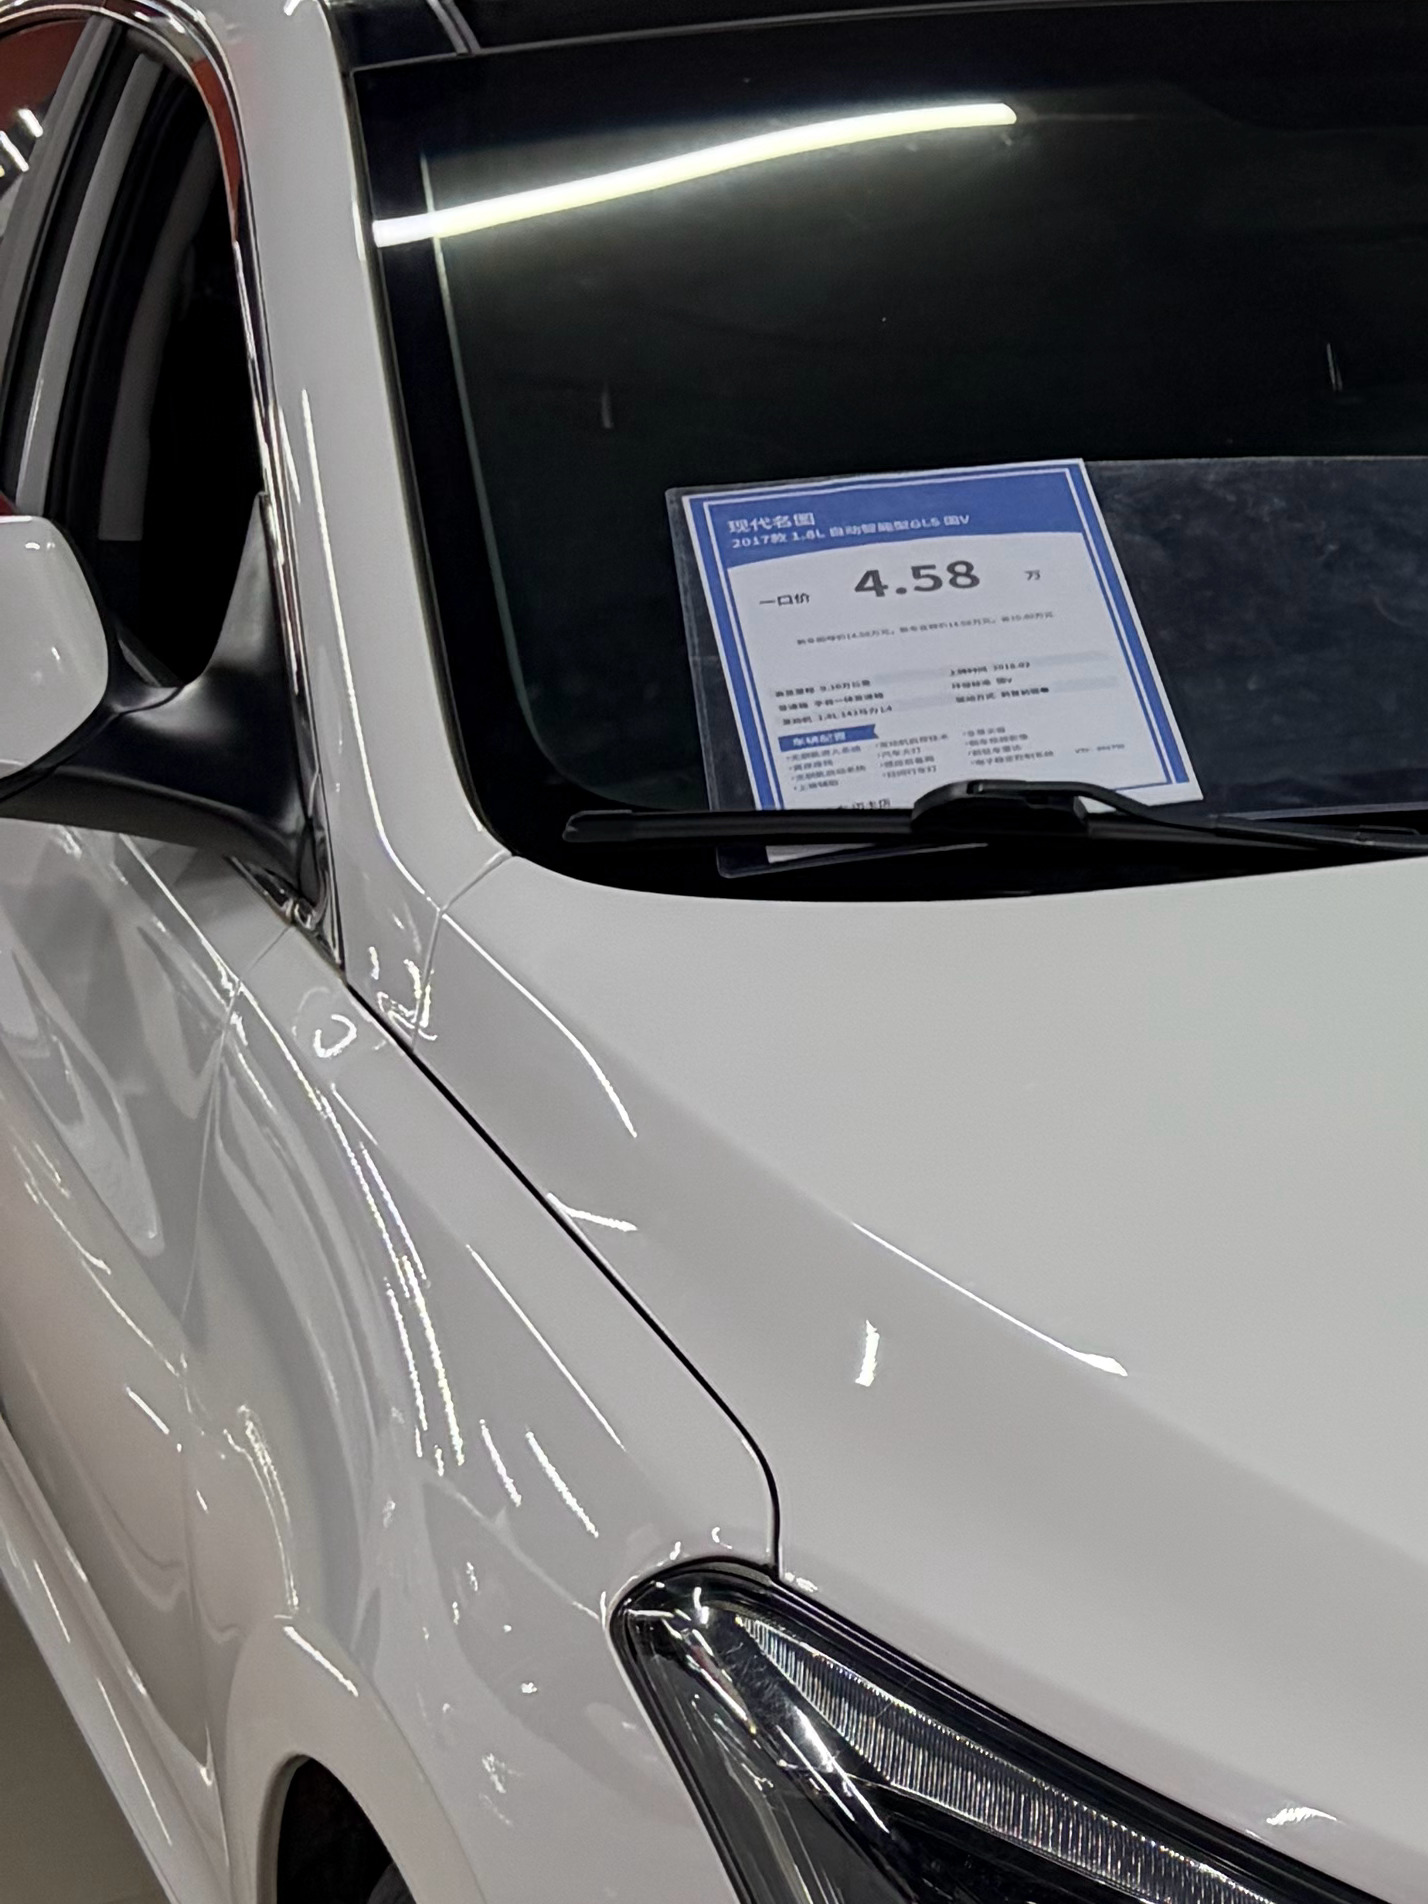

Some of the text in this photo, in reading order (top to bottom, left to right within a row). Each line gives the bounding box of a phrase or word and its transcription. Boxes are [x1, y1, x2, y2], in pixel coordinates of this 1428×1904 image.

[727, 513, 815, 534] 现代名图
[732, 533, 787, 549] 2017款
[854, 560, 980, 597] 4.58
[759, 592, 810, 607] 一口价
